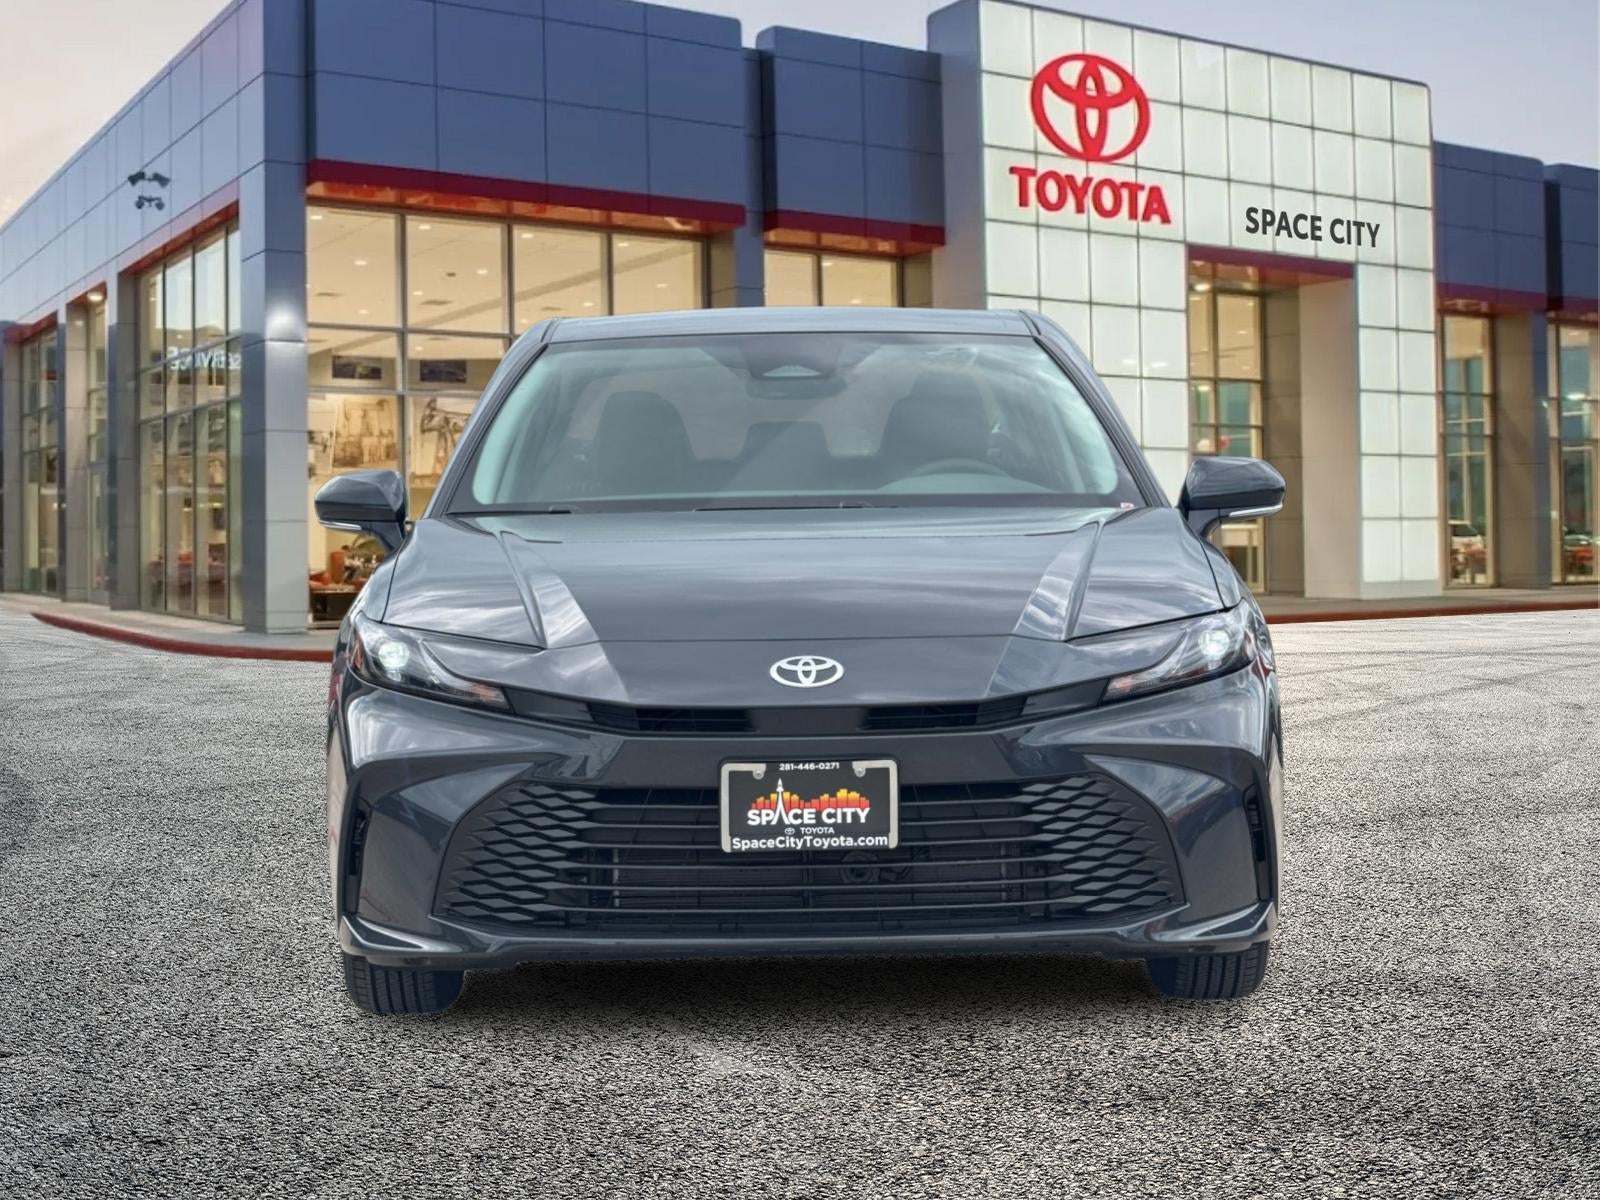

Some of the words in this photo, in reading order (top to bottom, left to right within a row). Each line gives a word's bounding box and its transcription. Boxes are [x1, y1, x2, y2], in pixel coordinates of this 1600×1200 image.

[1009, 166, 1171, 224] TOYOTA
[1245, 206, 1322, 242] SPACE
[1329, 217, 1381, 248] CITY
[779, 762, 840, 771] 281-446-0271
[821, 807, 870, 824] CITY
[800, 827, 835, 835] TOYOTA
[732, 835, 888, 851] SpaceCityToyota.com
